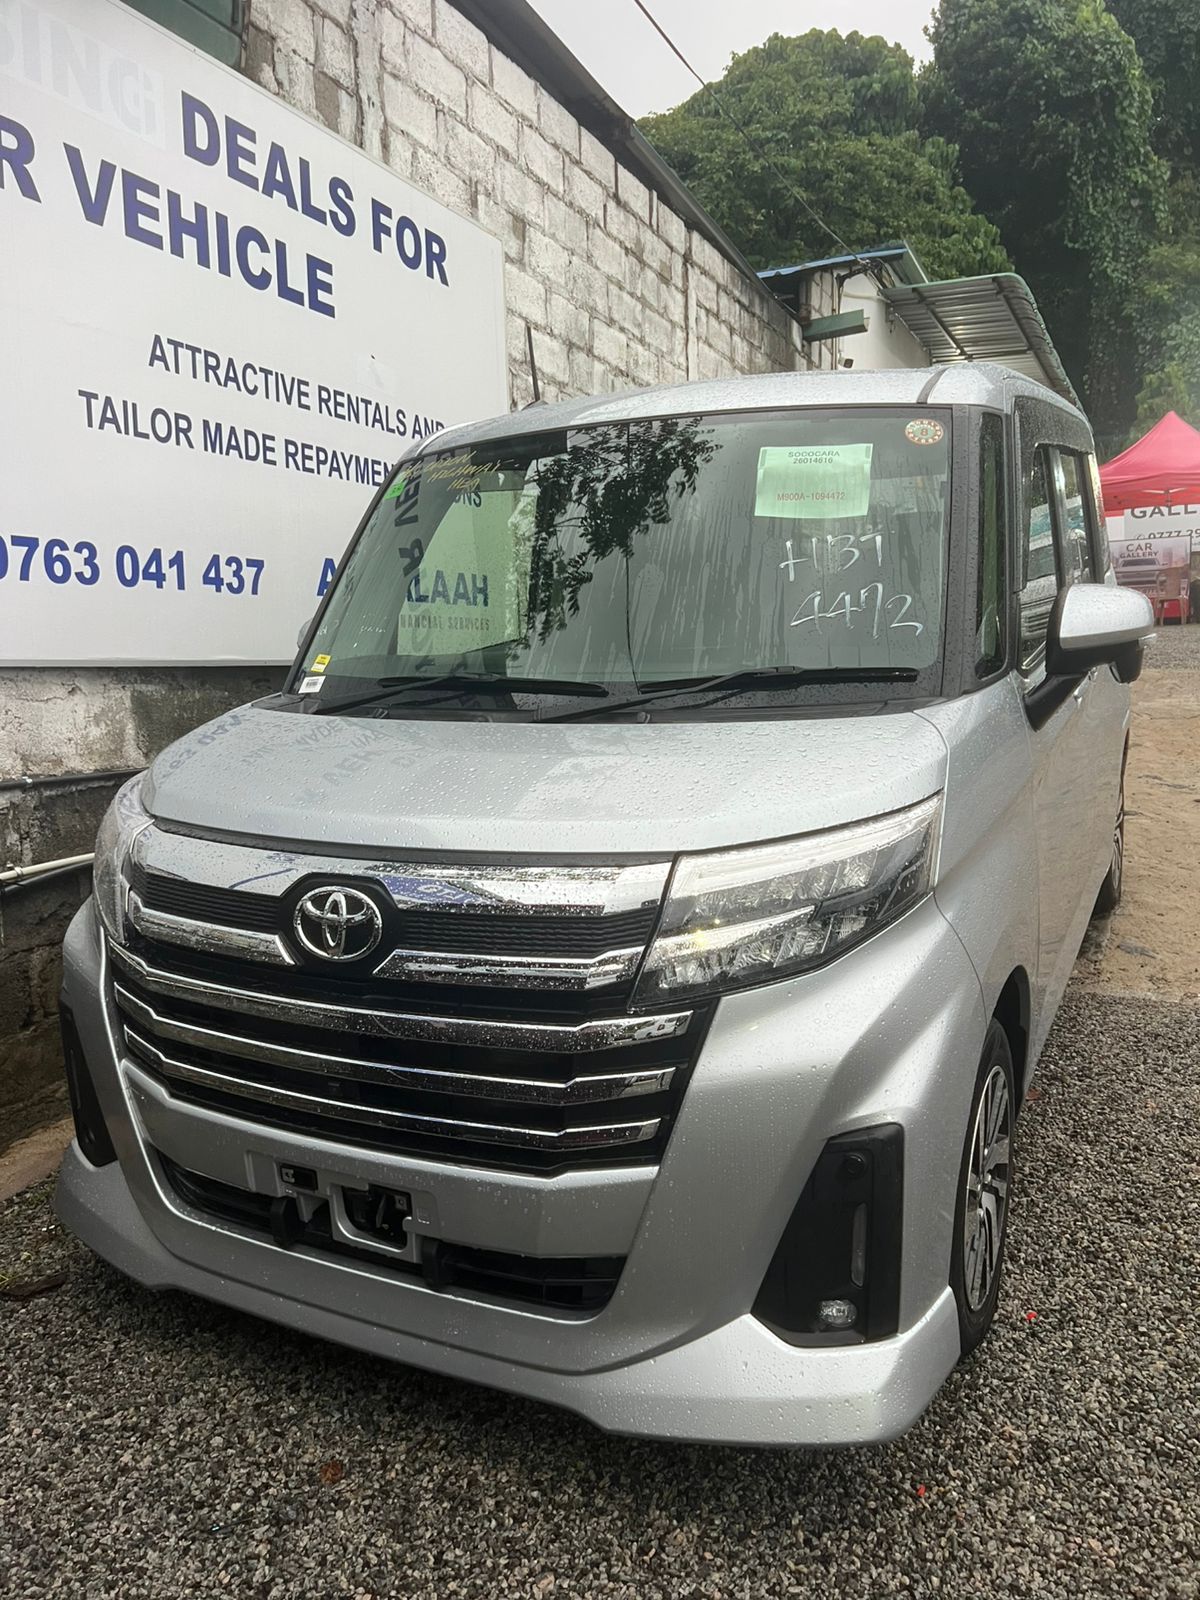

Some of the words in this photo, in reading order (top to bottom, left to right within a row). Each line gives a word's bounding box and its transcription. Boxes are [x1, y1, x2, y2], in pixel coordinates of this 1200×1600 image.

[182, 91, 357, 237] DEALS
[372, 198, 449, 287] FOR
[63, 142, 335, 318] VEHICLE
[149, 334, 311, 411] ATTRACTIVE
[318, 385, 407, 437] RENTALS
[78, 389, 195, 450] TAILOR
[203, 419, 278, 467] MADE
[116, 545, 186, 591] 041
[202, 554, 265, 596] 437
[1120, 551, 1159, 559] GALLERY
[1126, 542, 1153, 552] CAR
[790, 582, 924, 639] 4472
